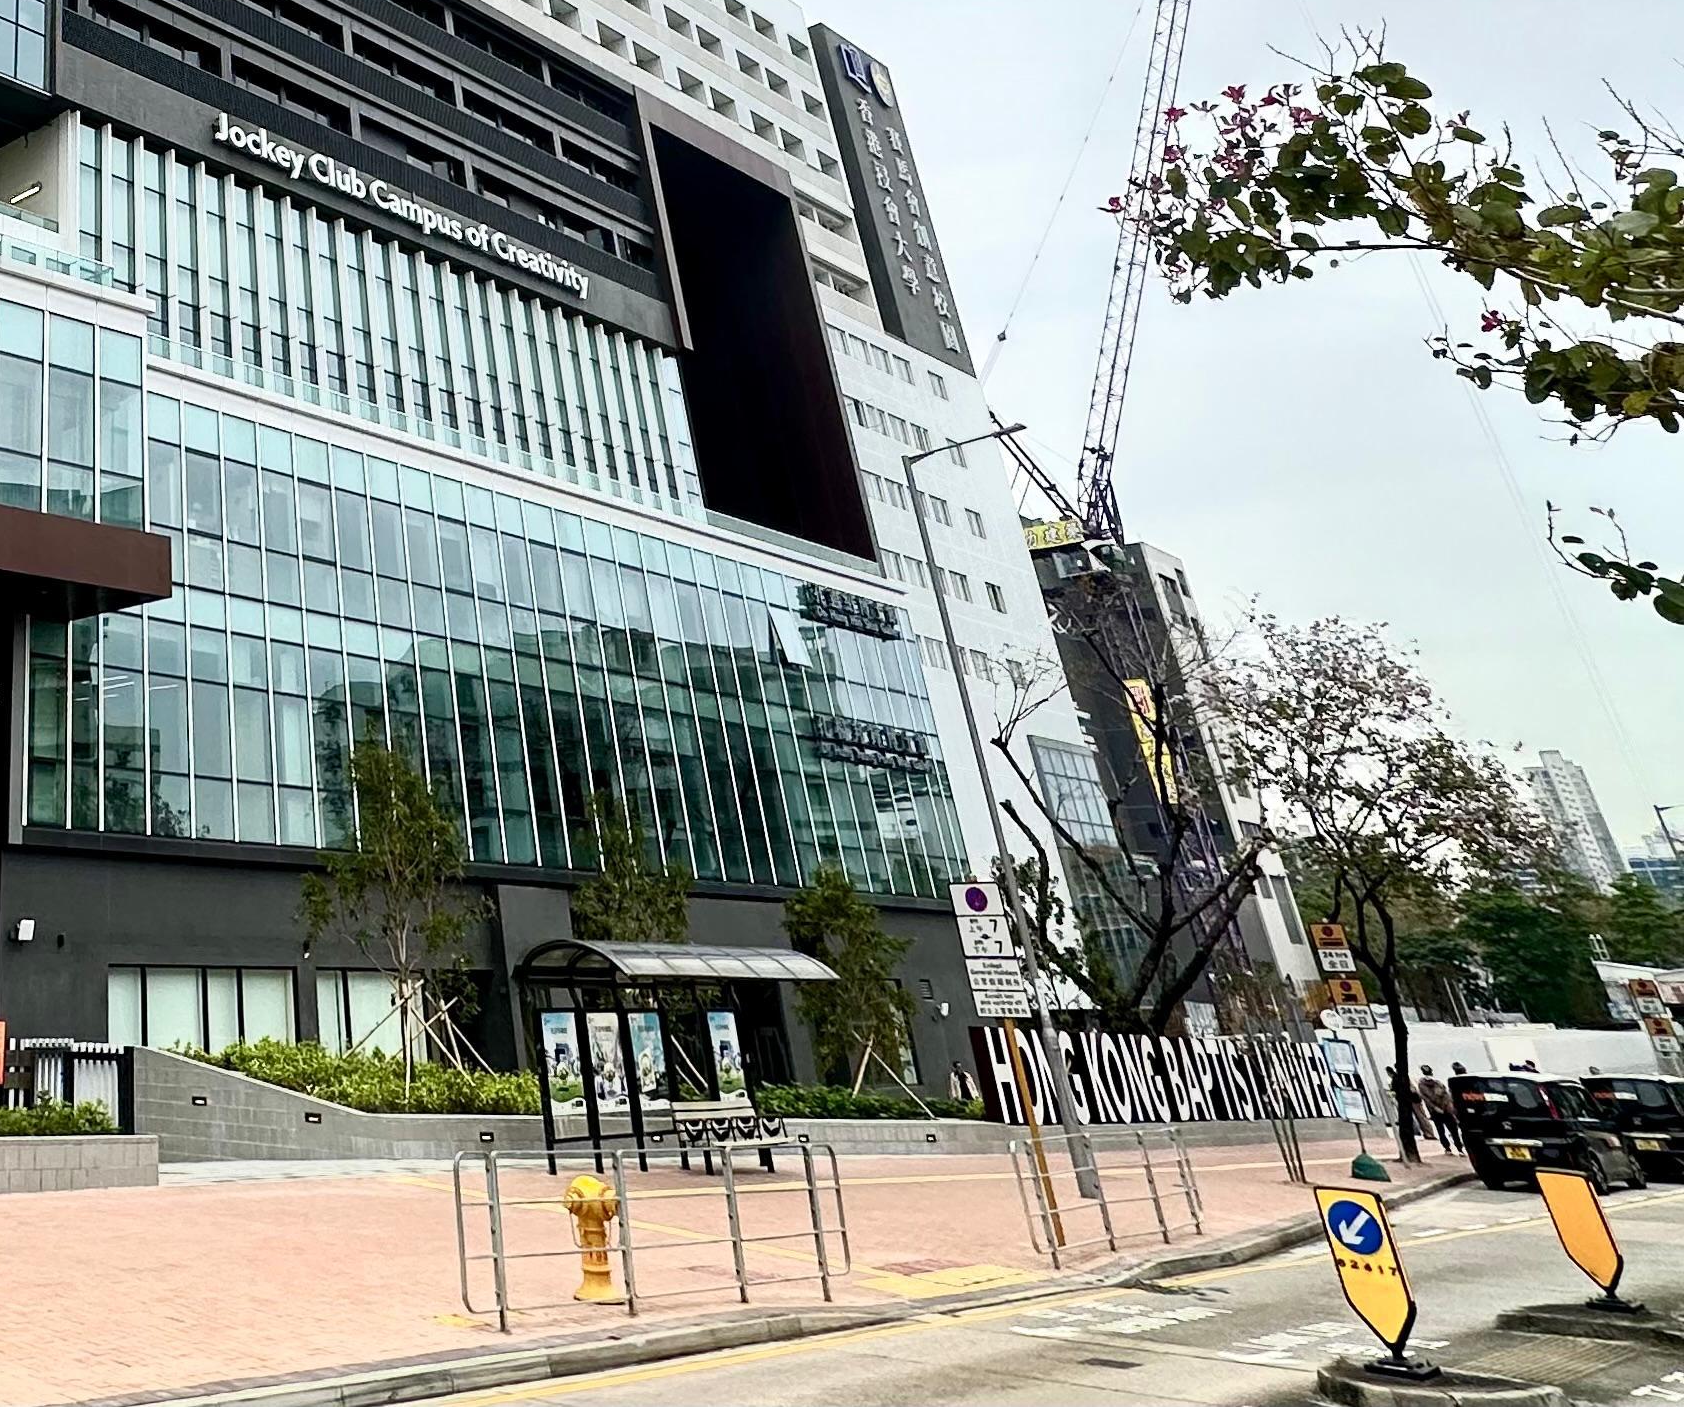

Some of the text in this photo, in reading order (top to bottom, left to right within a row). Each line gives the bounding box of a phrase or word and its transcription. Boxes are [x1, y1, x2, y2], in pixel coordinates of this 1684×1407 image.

[215, 112, 590, 300] Jockey Club Campus of Creativity
[855, 97, 921, 295] 香港浸會大學
[989, 919, 997, 933] 7
[994, 940, 1002, 954] 7
[1328, 960, 1349, 969] 全日
[984, 1026, 1091, 1125] HONG
[1079, 1031, 1172, 1124] KONG
[1159, 1035, 1266, 1122] BAPTIST
